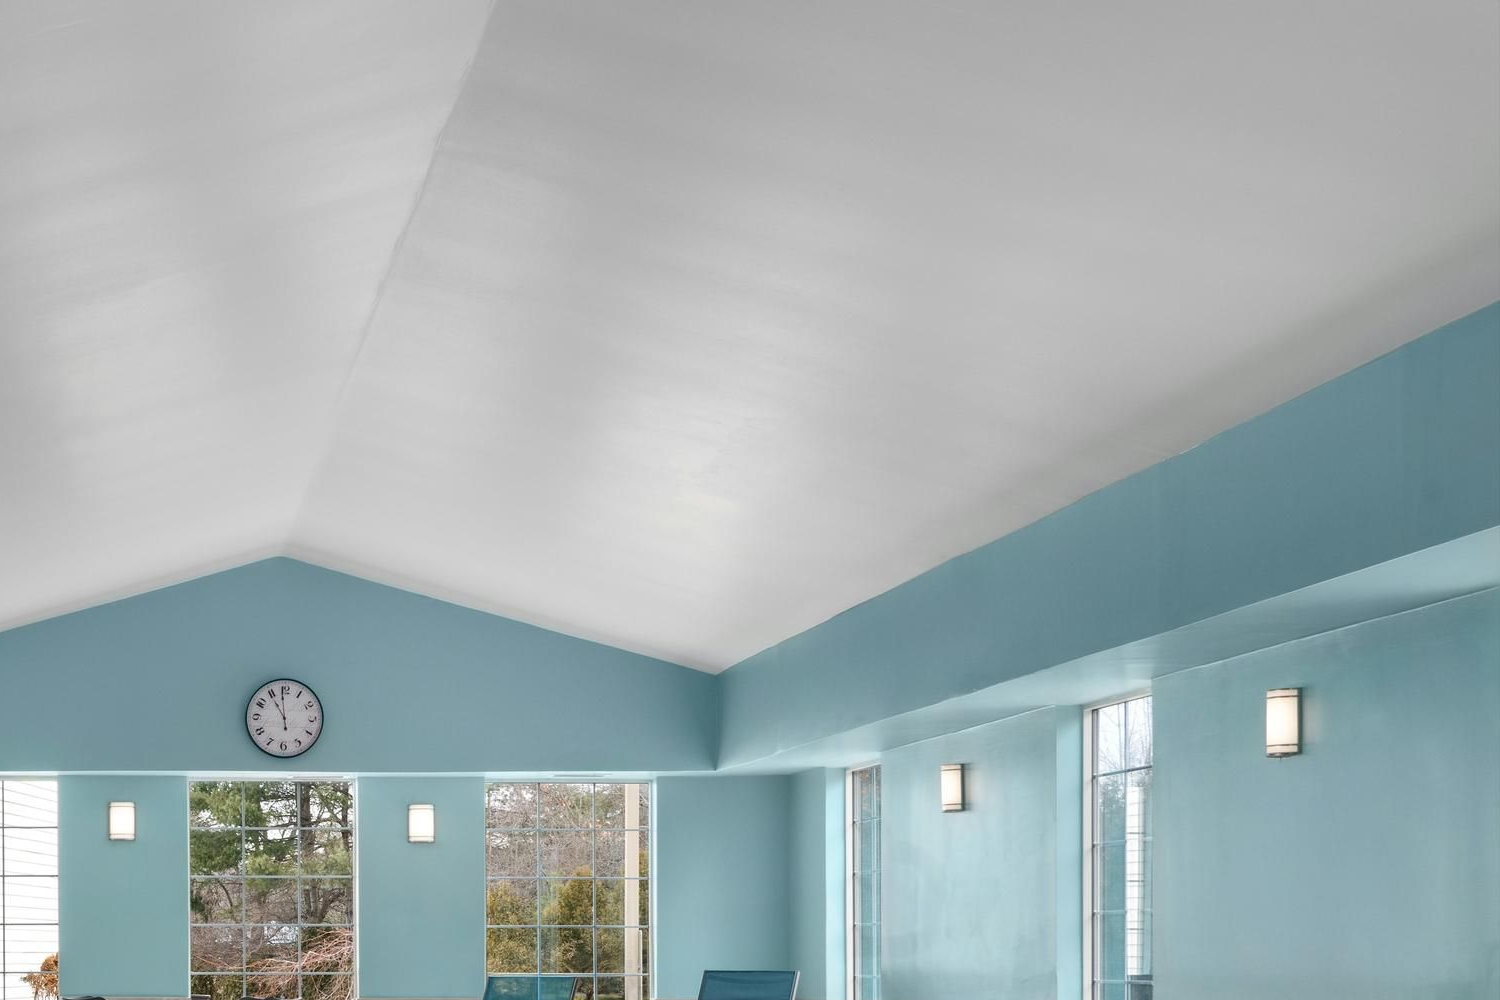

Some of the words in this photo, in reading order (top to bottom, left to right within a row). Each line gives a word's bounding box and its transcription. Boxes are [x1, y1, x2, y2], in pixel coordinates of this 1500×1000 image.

[268, 688, 276, 698] 11
[296, 690, 302, 698] 1
[256, 698, 266, 708] 10
[304, 701, 313, 710] 2
[255, 727, 265, 735] 8
[266, 737, 275, 745] 7
[280, 741, 287, 751] 6
